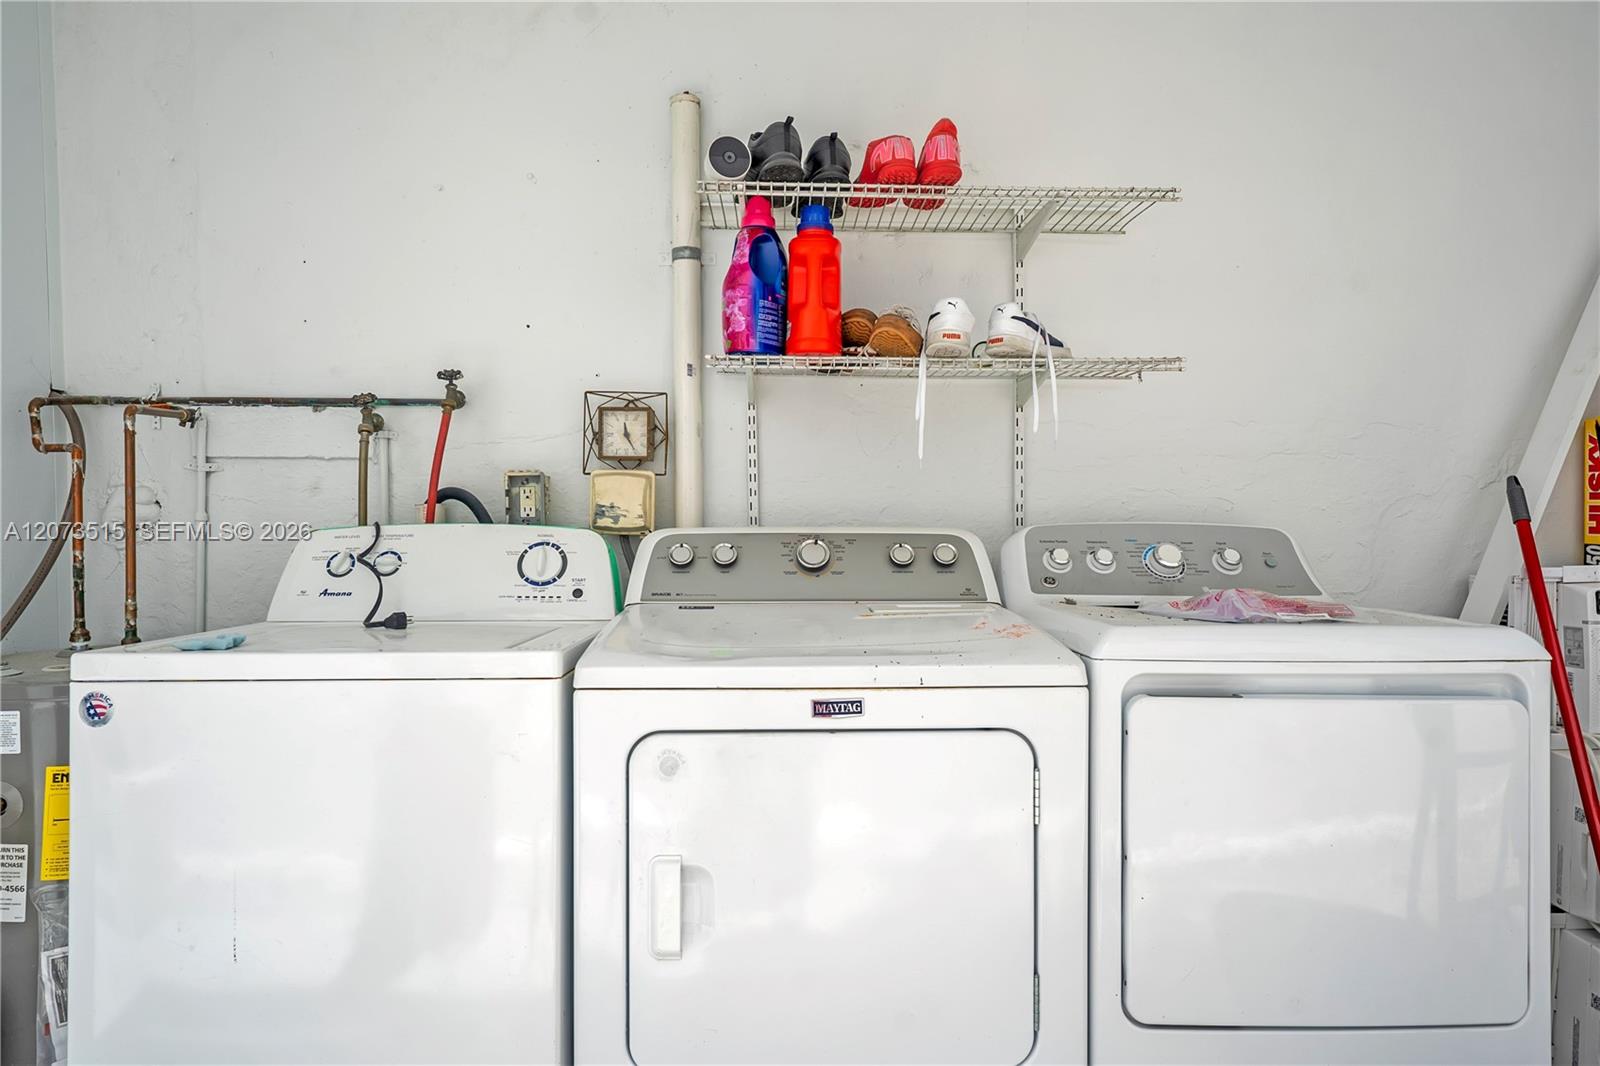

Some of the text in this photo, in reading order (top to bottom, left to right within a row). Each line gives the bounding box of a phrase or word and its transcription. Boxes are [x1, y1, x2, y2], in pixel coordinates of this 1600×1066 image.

[988, 337, 1004, 345] PUMA
[319, 588, 352, 597] Amana
[84, 692, 113, 709] AMERICA
[814, 702, 861, 714] MAYTAG
